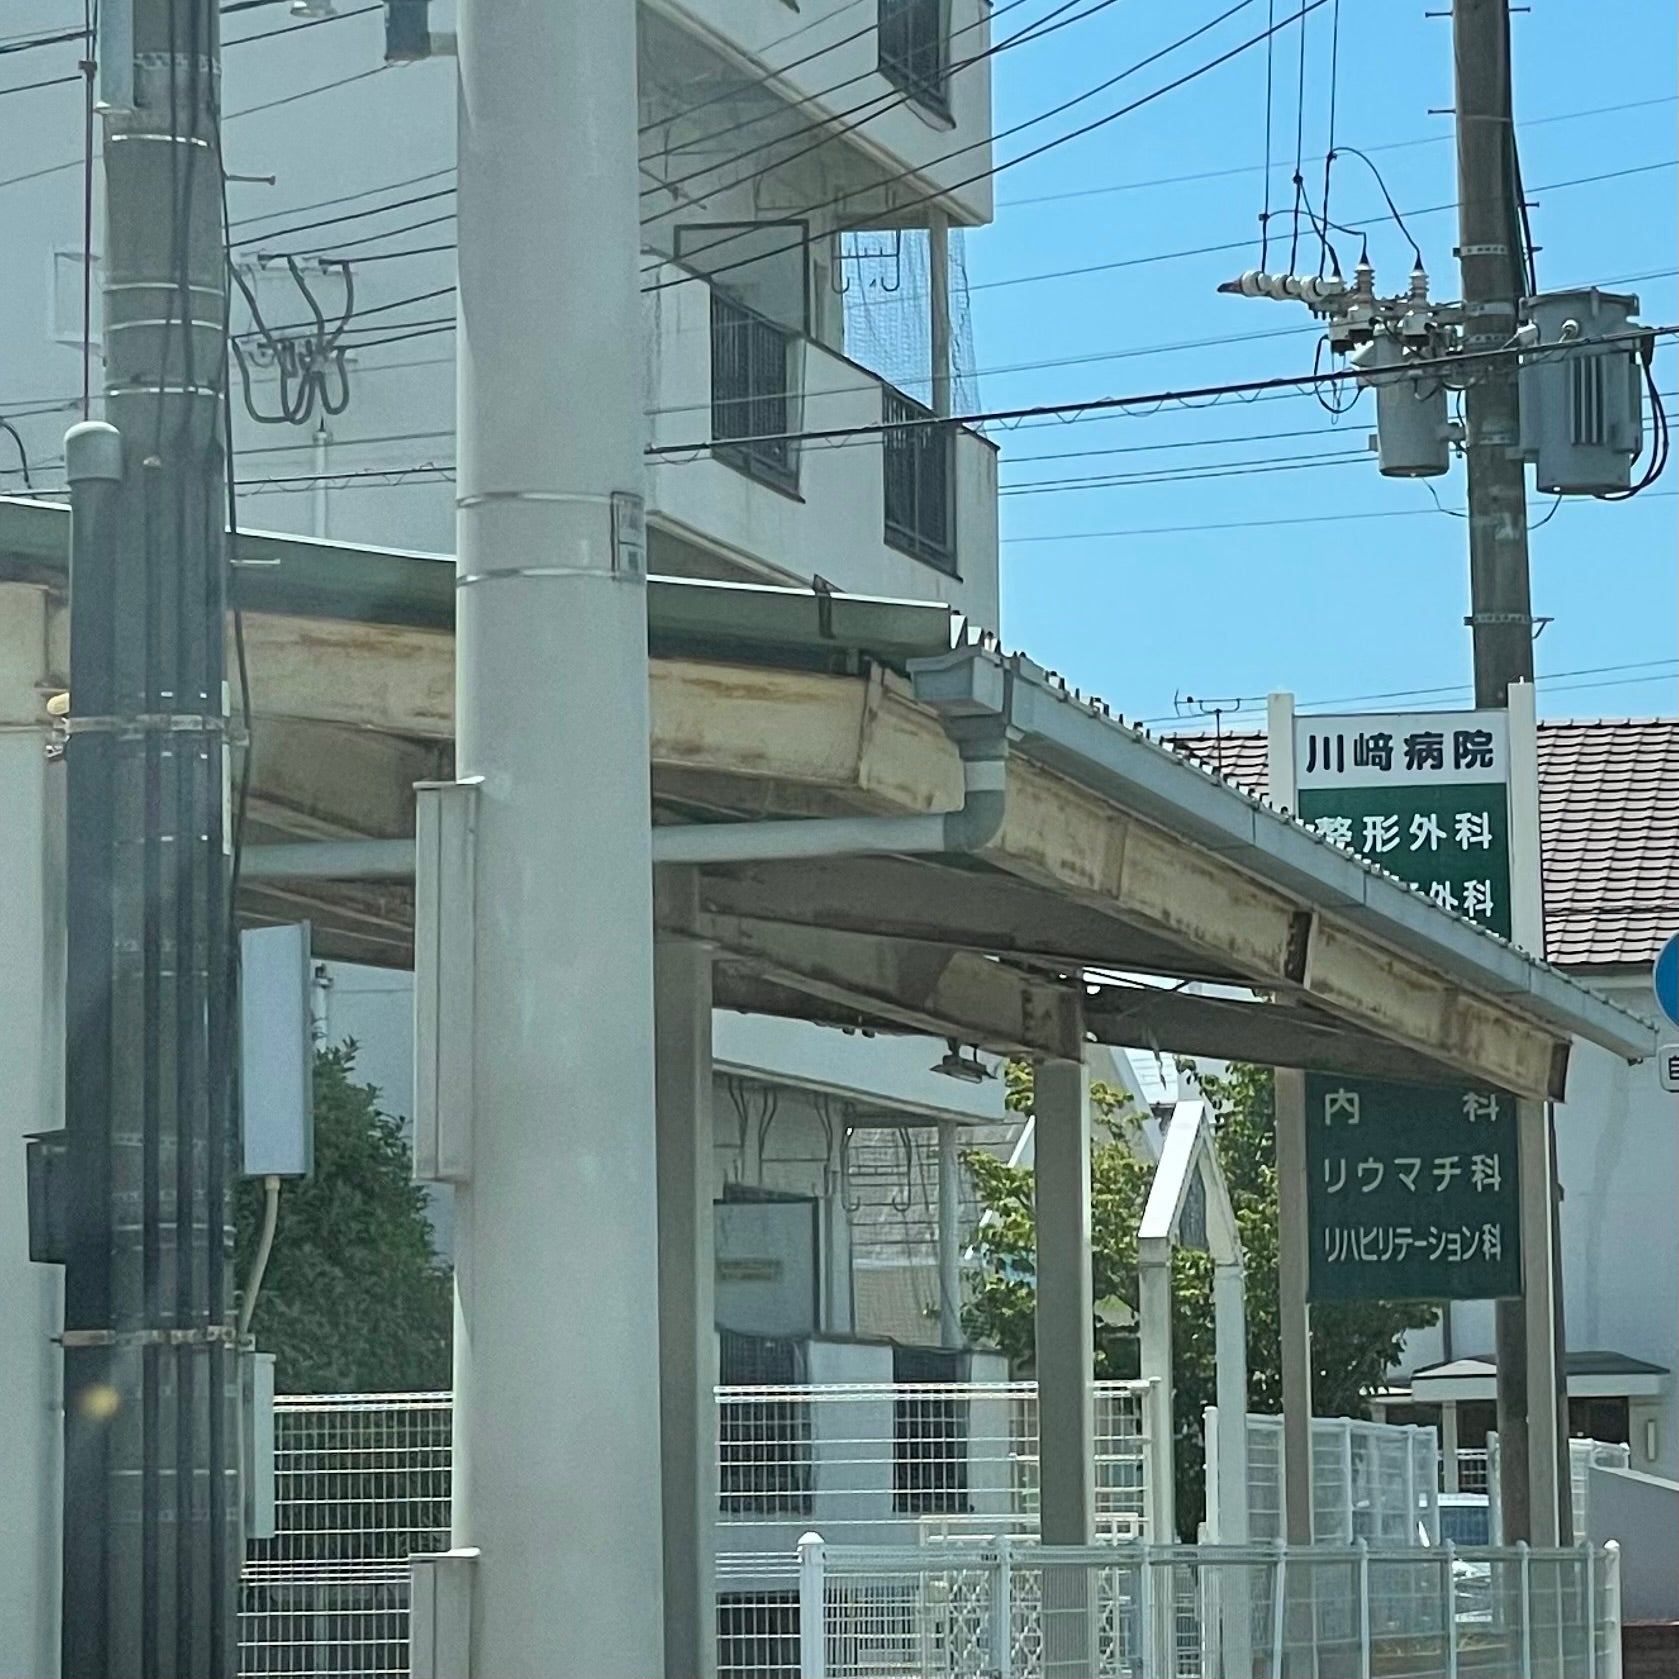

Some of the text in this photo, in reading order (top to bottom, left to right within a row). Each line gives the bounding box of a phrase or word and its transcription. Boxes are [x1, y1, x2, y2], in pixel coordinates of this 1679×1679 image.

[1314, 811, 1493, 854] 整形外科
[1410, 879, 1495, 918] 外科
[1324, 1153, 1502, 1194] リウマチ科
